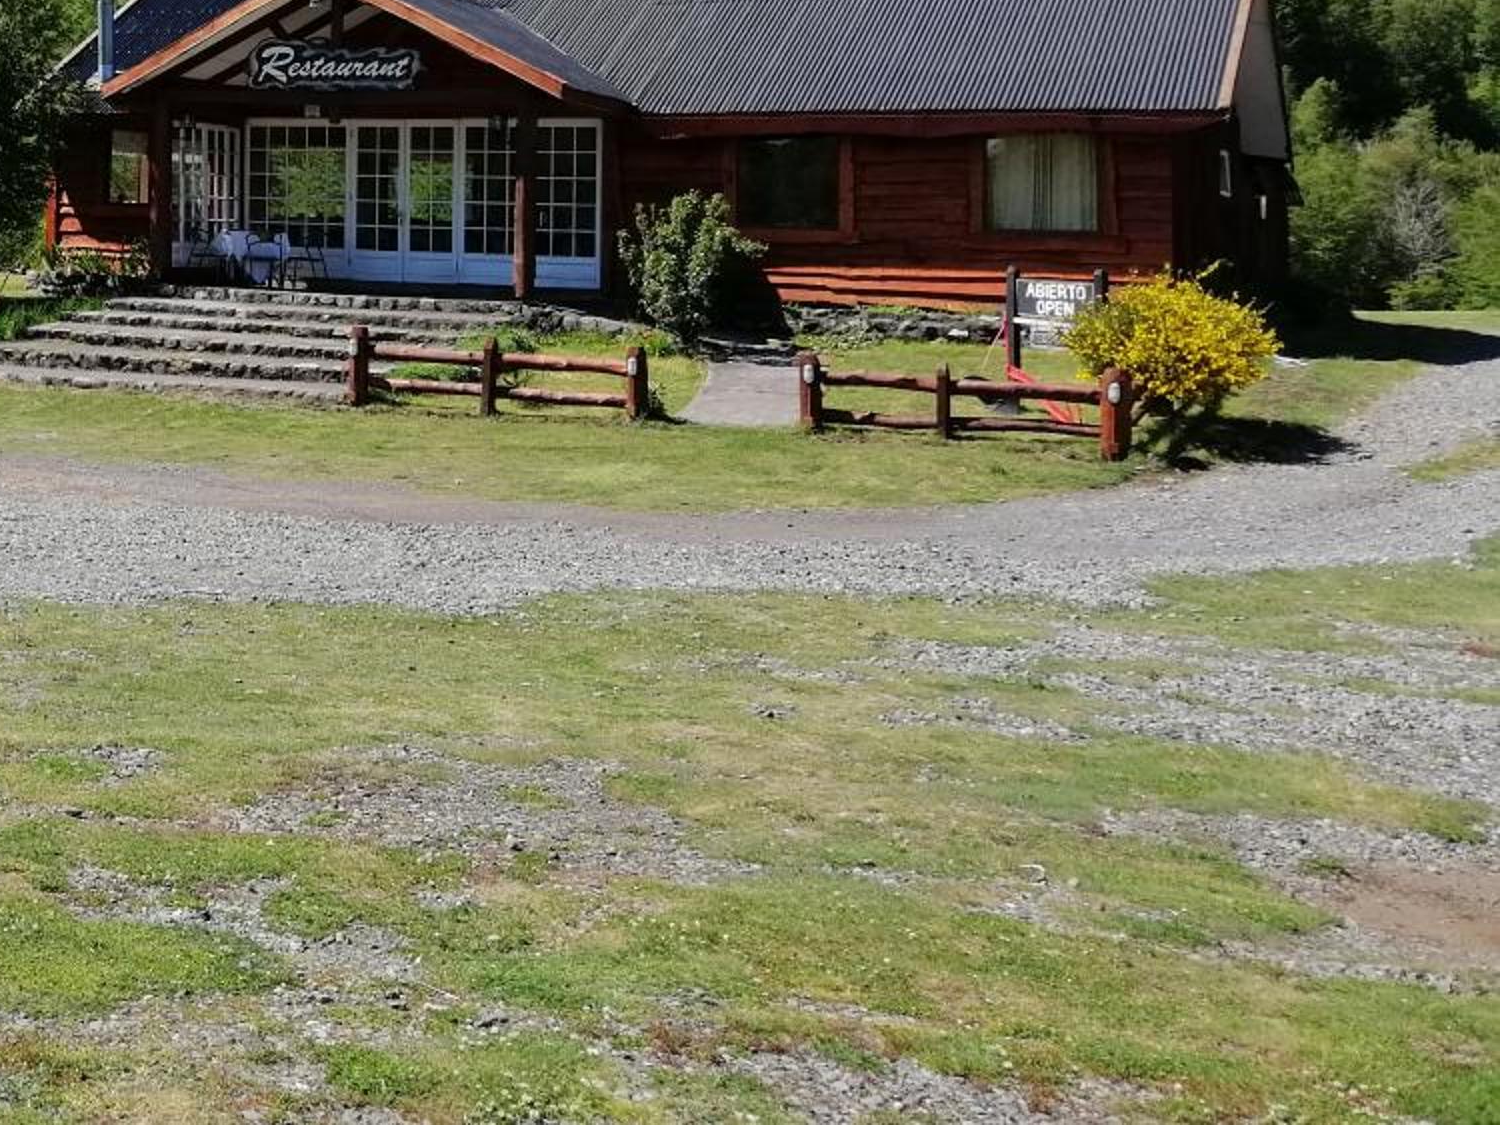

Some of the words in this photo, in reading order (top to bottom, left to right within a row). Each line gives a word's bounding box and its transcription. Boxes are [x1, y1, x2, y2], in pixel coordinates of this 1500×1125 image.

[258, 46, 411, 83] Restaurant
[1025, 283, 1087, 300] ABIERTO
[1036, 300, 1076, 316] OPEN
